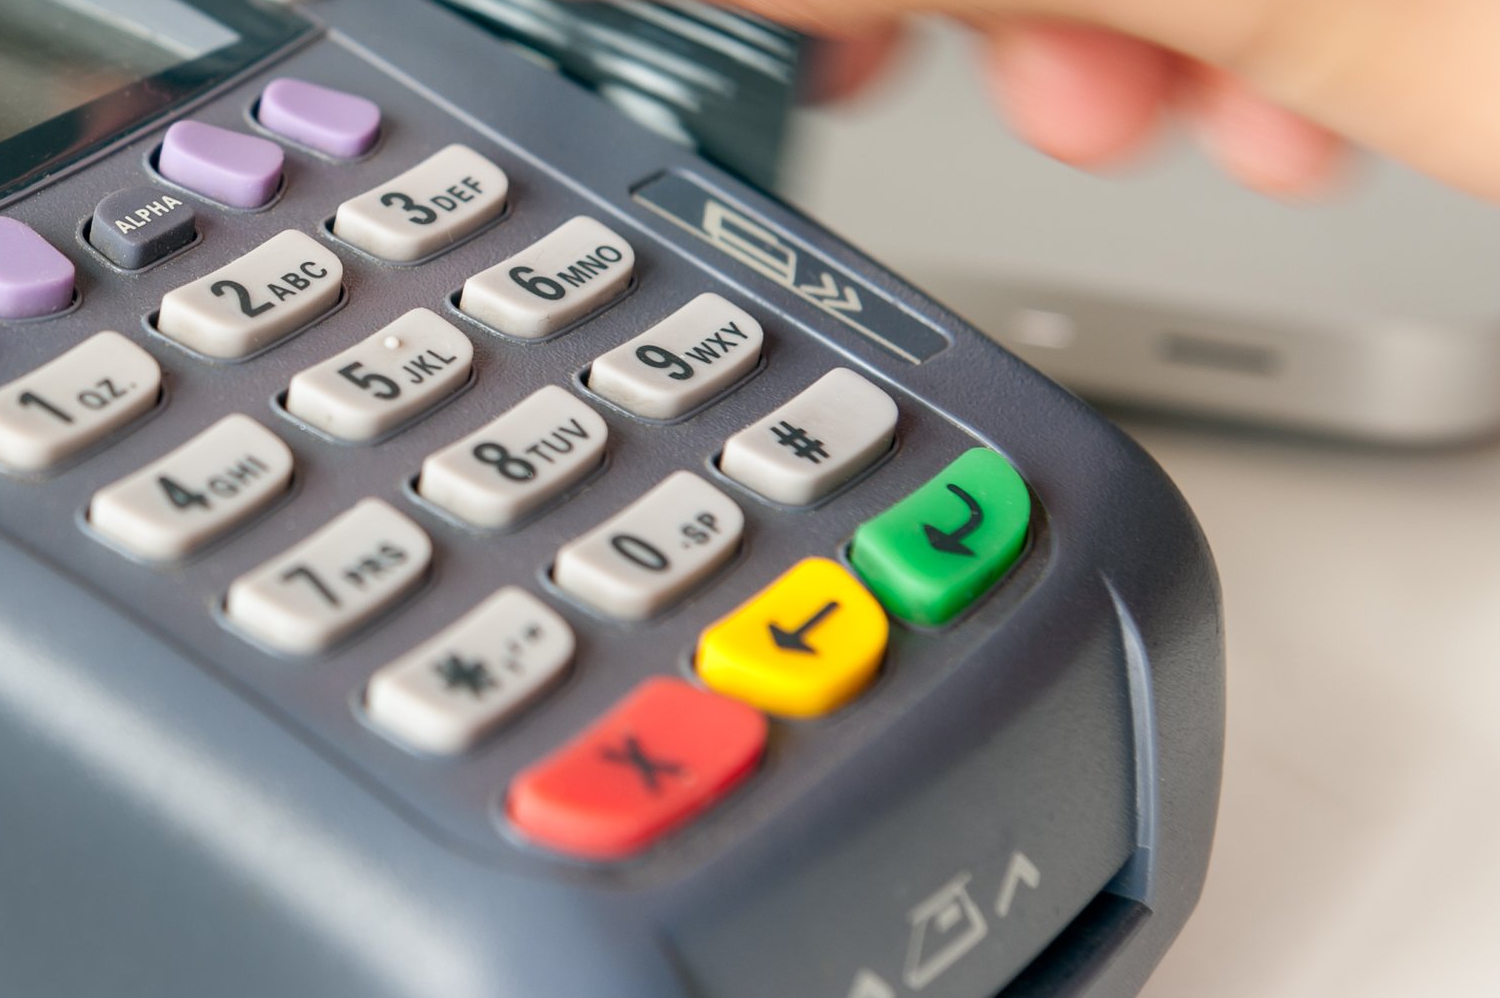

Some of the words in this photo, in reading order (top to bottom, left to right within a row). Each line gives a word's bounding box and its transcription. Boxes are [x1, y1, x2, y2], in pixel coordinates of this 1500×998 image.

[114, 195, 183, 234] ALPHA
[380, 191, 437, 225] 3
[430, 176, 483, 213] DEF
[210, 279, 276, 319] 2
[267, 261, 328, 302] ABC
[509, 265, 566, 301] 6
[557, 245, 623, 287] MNO
[337, 361, 401, 400] 5
[402, 349, 457, 384] JKL
[635, 344, 695, 381] 9
[684, 321, 749, 365] WXY
[18, 390, 74, 424] 1
[472, 442, 538, 483] 8
[526, 418, 590, 463] TUV
[157, 476, 211, 511] 4
[206, 454, 269, 498] GHI
[281, 564, 341, 607] 7
[343, 544, 408, 589] PRS
[610, 534, 670, 574] 0
